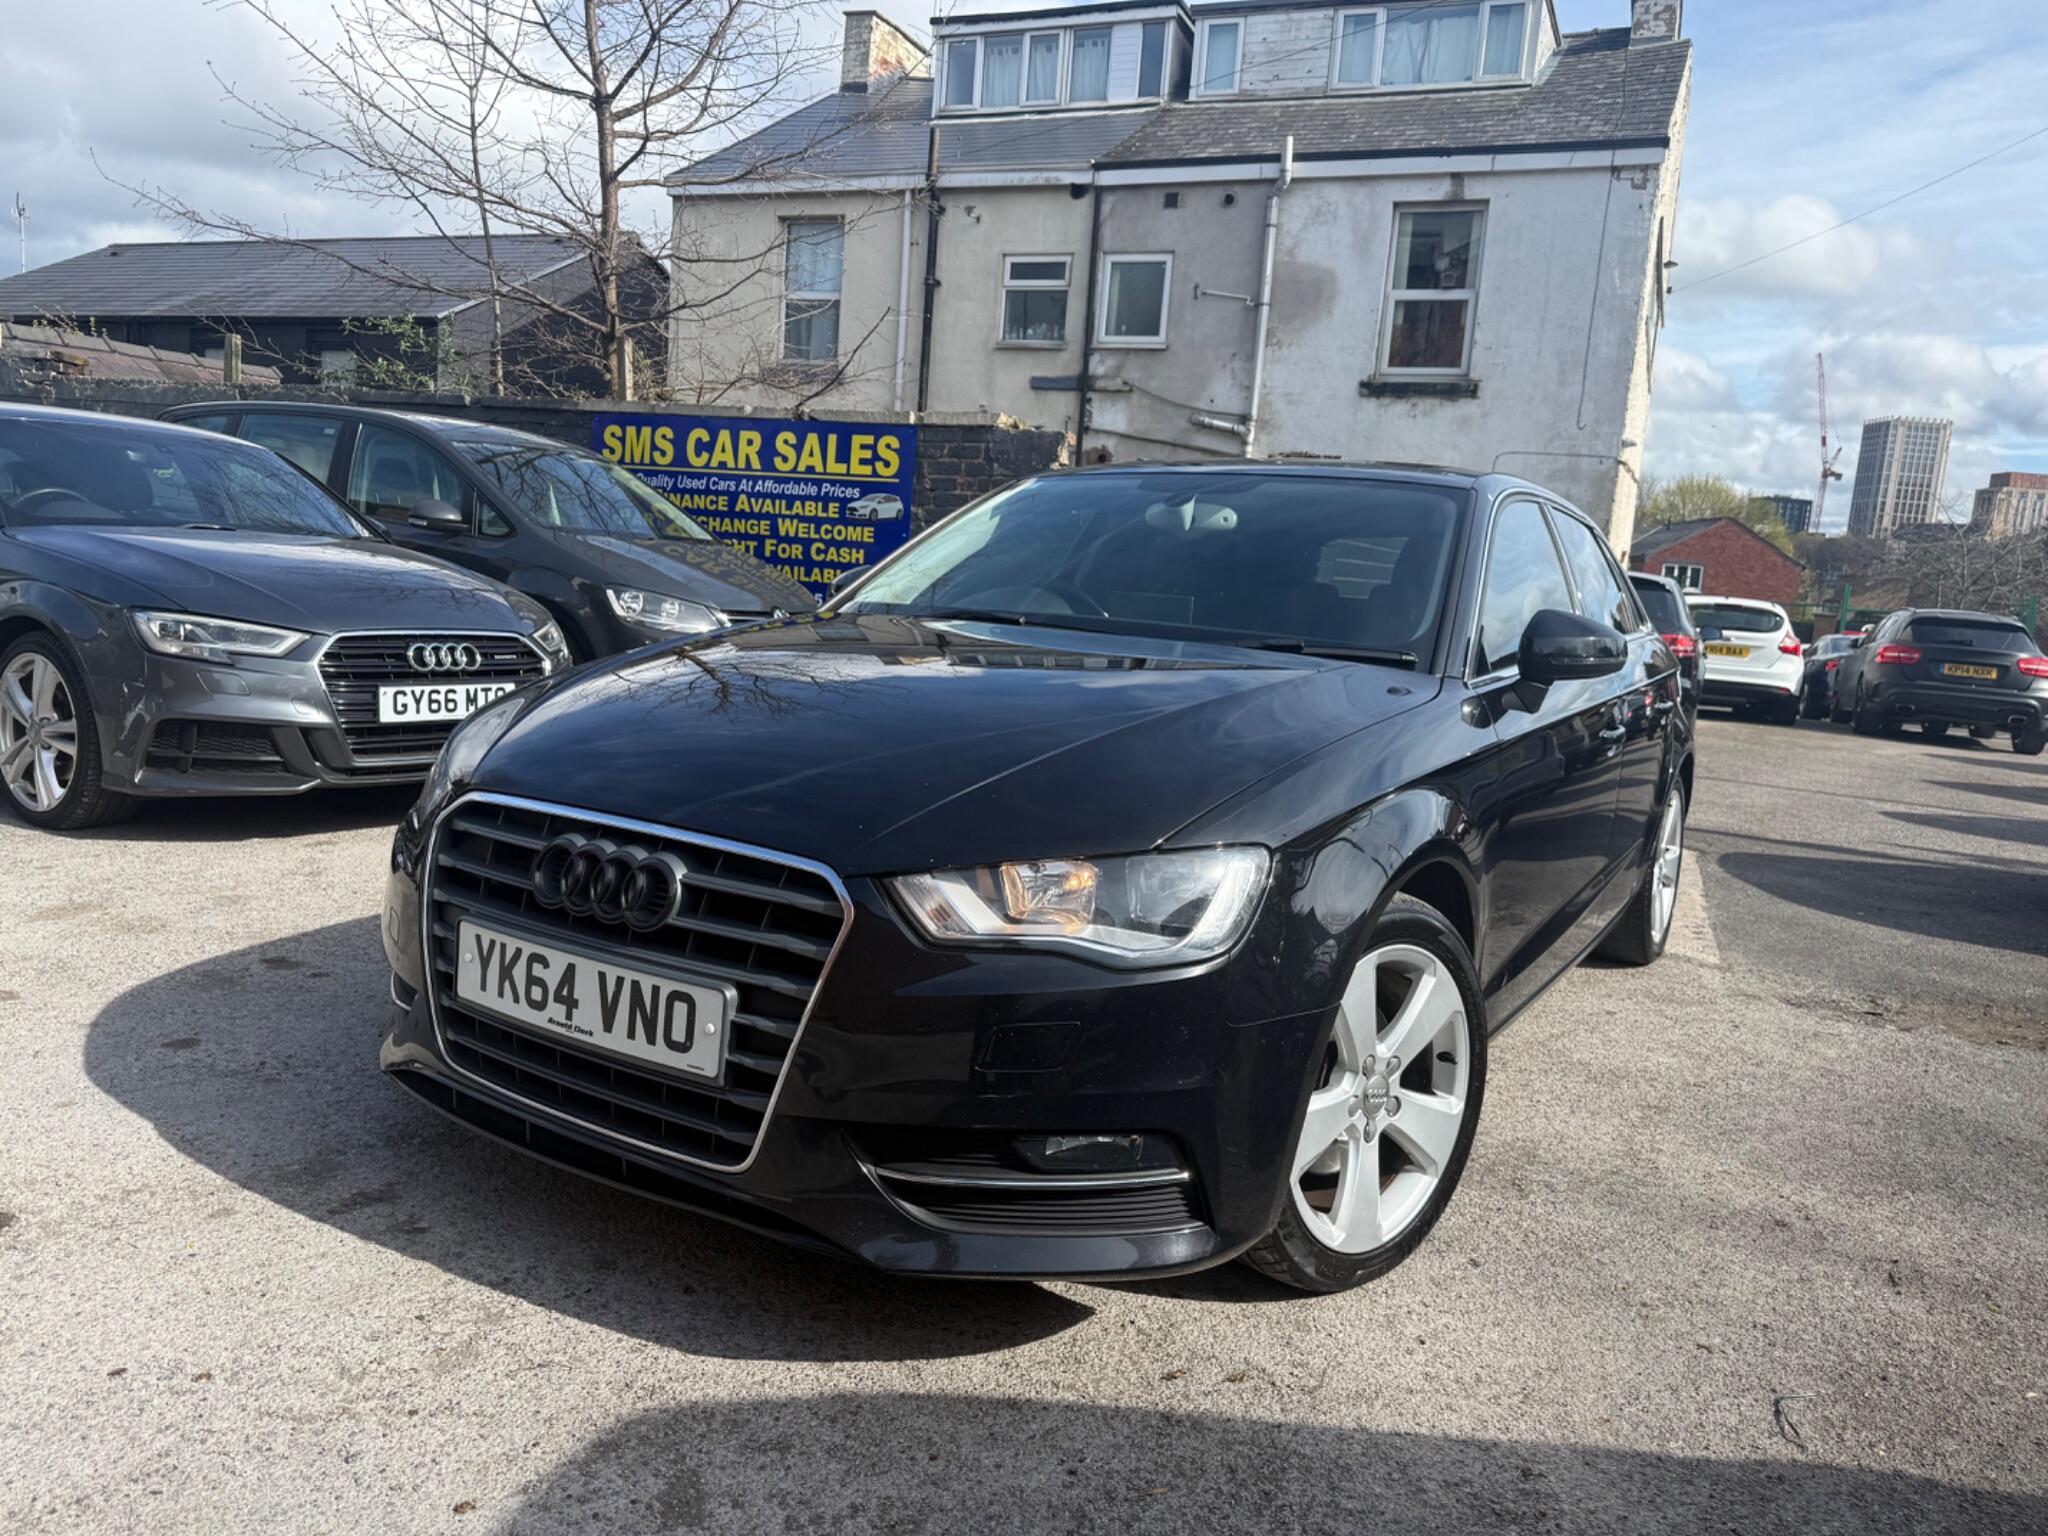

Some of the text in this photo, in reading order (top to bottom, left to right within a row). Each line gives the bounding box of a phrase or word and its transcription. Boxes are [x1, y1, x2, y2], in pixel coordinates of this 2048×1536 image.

[602, 424, 900, 477] SMS CAR SALES
[676, 474, 707, 490] Used
[709, 476, 737, 491] Cars
[738, 478, 753, 492] At
[754, 480, 818, 496] Affordable
[821, 483, 860, 498] Prices
[659, 490, 840, 518] NANCE AVAILABLE
[777, 518, 875, 542] WELCOME
[764, 539, 803, 559] FOR
[810, 542, 864, 564] CASH
[392, 688, 458, 715] GY66
[475, 933, 697, 1054] YK64 VNO
